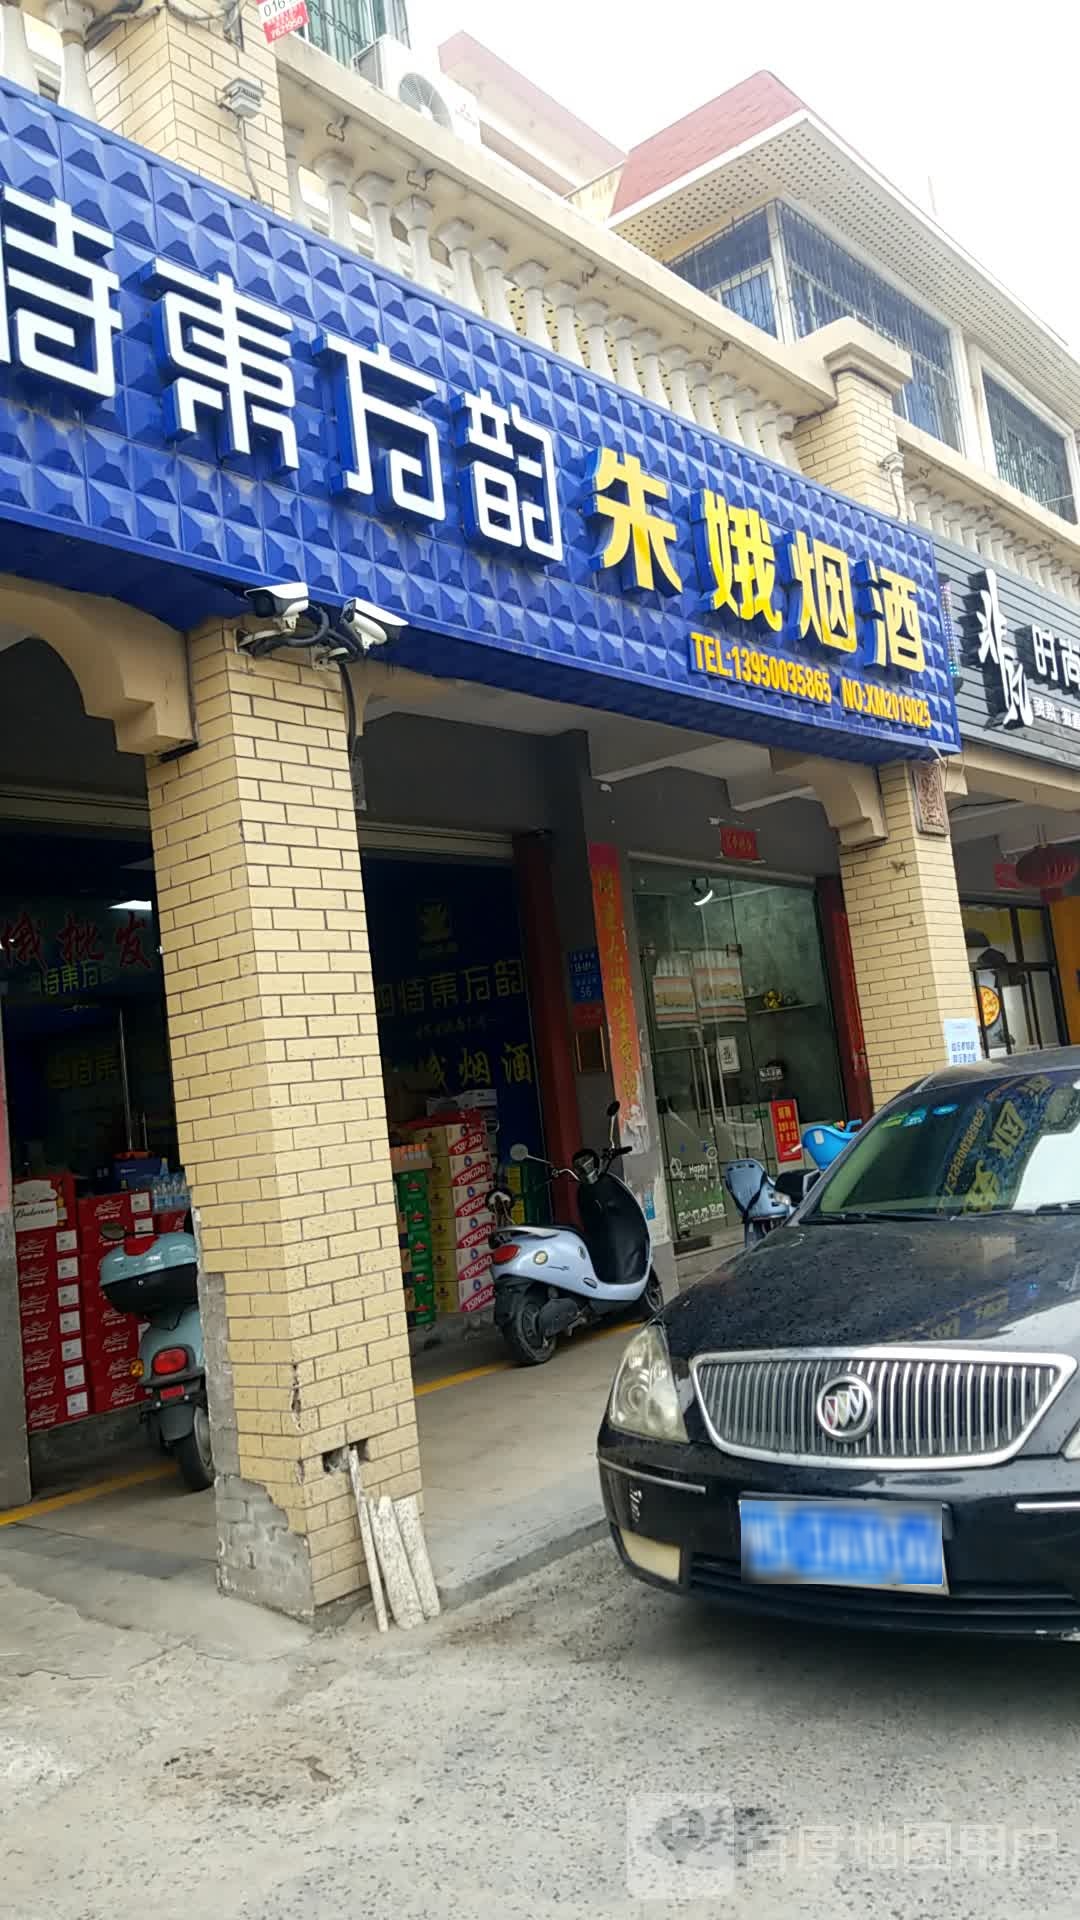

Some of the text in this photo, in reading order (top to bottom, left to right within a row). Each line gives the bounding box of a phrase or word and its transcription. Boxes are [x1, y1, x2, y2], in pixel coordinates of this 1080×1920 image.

[596, 447, 926, 673] 朱娥烟酒
[690, 632, 932, 729] TEL:13950035865 NO:XM2019025
